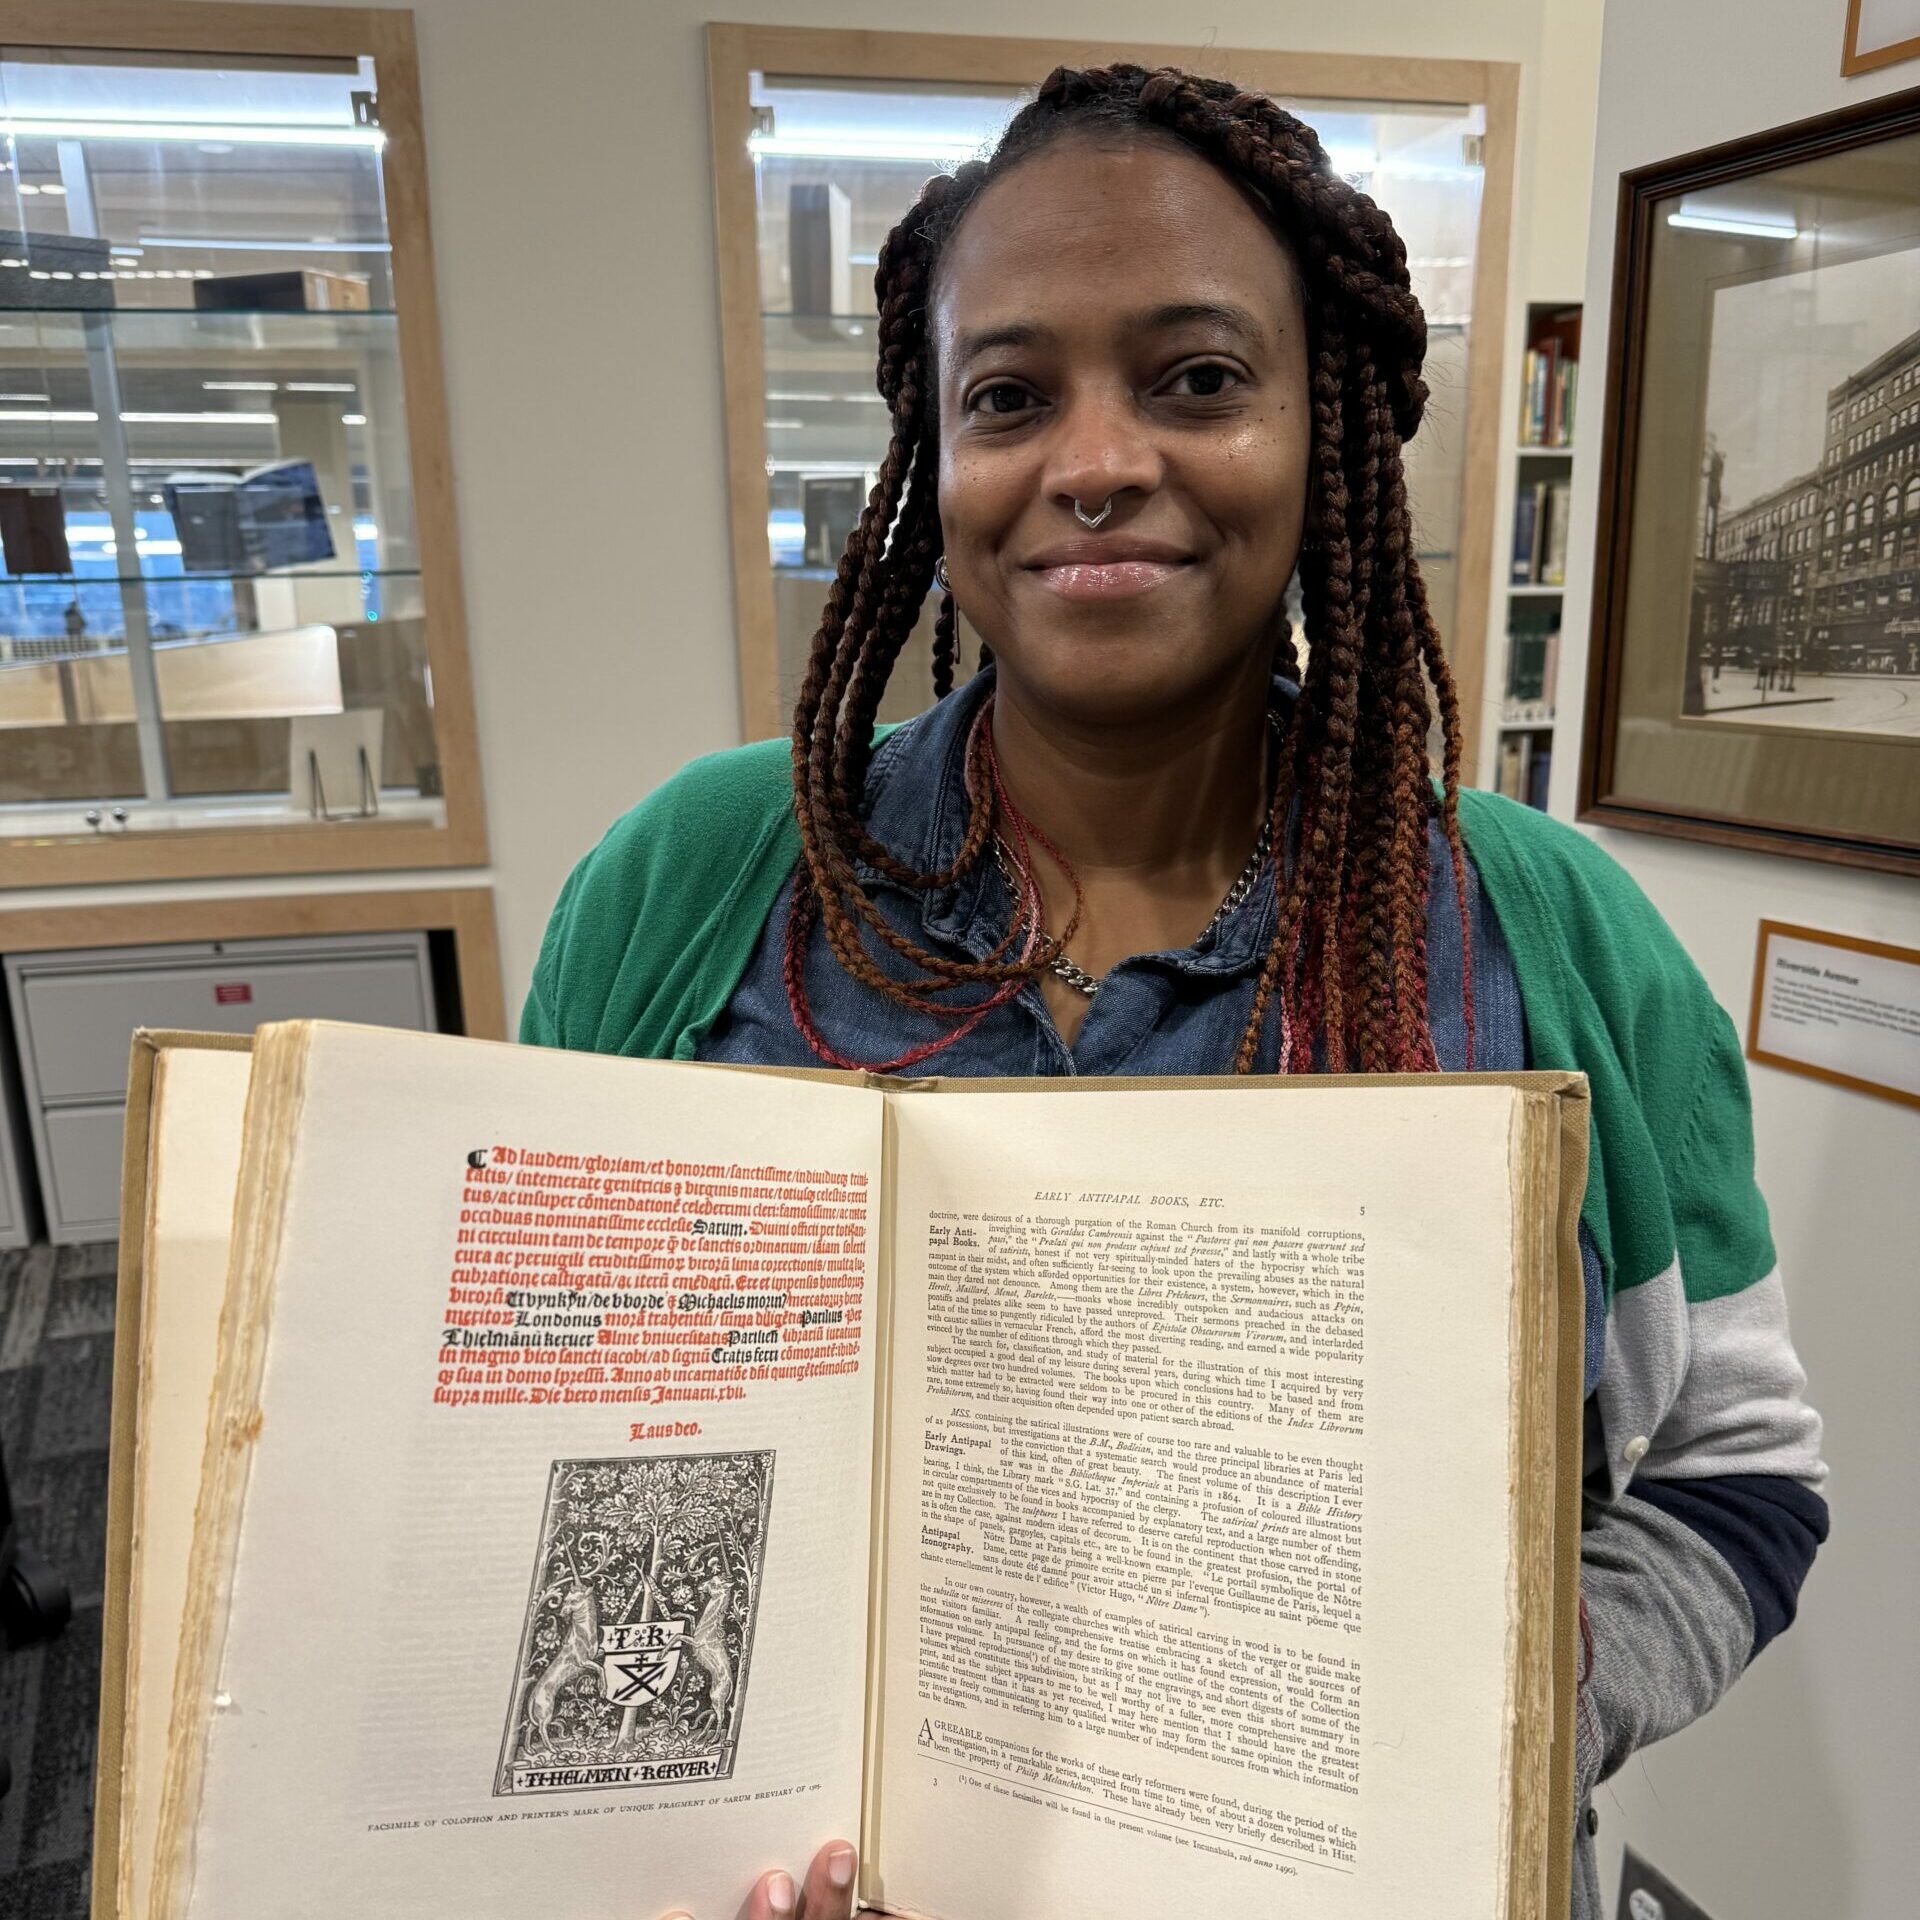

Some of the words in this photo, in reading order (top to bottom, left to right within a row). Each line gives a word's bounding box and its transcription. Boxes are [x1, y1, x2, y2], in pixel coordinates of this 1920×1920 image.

[1823, 969, 1859, 986] Avenue
[1034, 1190, 1072, 1201] EARLY
[1078, 1192, 1140, 1204] ANTIPAPAL
[1149, 1196, 1189, 1207] BOOKS,
[1198, 1197, 1224, 1207] ETC.
[1360, 1206, 1365, 1216] 5
[928, 1210, 959, 1221] doctrine,
[981, 1212, 1012, 1222] desirous
[1014, 1214, 1023, 1222] of
[1035, 1215, 1070, 1227] thorough
[1074, 1218, 1112, 1228] purgation
[1115, 1219, 1124, 1228] of
[1128, 1220, 1142, 1228] the
[1146, 1220, 1176, 1230] Roman
[1180, 1222, 1212, 1232] Church
[1217, 1223, 1238, 1233] from
[1242, 1224, 1254, 1234] its
[1260, 1226, 1300, 1236] manifold
[1307, 1229, 1364, 1241] corruptions,
[929, 1225, 950, 1236] Early
[954, 1226, 976, 1235] Anti-
[928, 1236, 949, 1246] papal
[952, 1236, 979, 1246] Books.
[926, 1323, 952, 1332] evinced
[954, 1325, 963, 1336] by
[965, 1326, 978, 1335] the
[979, 1328, 1007, 1338] number
[1009, 1330, 1018, 1339] of
[1019, 1331, 1049, 1342] editions
[1051, 1334, 1082, 1347] through
[1085, 1338, 1108, 1348] which
[1111, 1340, 1129, 1353] they
[1132, 1344, 1161, 1354] passed.
[926, 1384, 974, 1399] Prohibitorum,
[976, 1391, 990, 1400] and
[992, 1392, 1009, 1402] their
[1011, 1396, 1052, 1408] acquisition
[1054, 1400, 1074, 1410] often
[1076, 1402, 1114, 1416] depended
[1117, 1410, 1137, 1420] upon
[1140, 1412, 1169, 1422] patient
[1171, 1416, 1198, 1426] search
[1201, 1418, 1234, 1431] abroad.
[924, 1431, 947, 1444] Early
[950, 1434, 991, 1448] Antipapal
[924, 1441, 965, 1456] Drawings.
[921, 1525, 960, 1540] Antipapal
[921, 1536, 974, 1554] Iconography.
[933, 1778, 938, 1786] 3
[984, 1736, 1029, 1754] companions
[1031, 1747, 1043, 1758] for
[1045, 1751, 1058, 1762] the
[1060, 1756, 1083, 1768] works
[1086, 1762, 1095, 1771] of
[1098, 1765, 1120, 1778] these
[1122, 1772, 1142, 1786] early
[1145, 1778, 1185, 1795] reformers
[1188, 1790, 1208, 1801] were
[1211, 1793, 1240, 1810] found,
[1242, 1801, 1272, 1820] during
[1276, 1810, 1291, 1822] the
[1294, 1816, 1324, 1830] period
[1327, 1823, 1338, 1834] of
[1341, 1827, 1357, 1838] the
[917, 1736, 930, 1747] had
[933, 1741, 950, 1753] been
[953, 1747, 966, 1758] the
[968, 1753, 1000, 1770] property
[1002, 1762, 1012, 1771] of
[1015, 1764, 1039, 1781] Philip
[1042, 1772, 1094, 1794] Melanchthon.
[1102, 1788, 1128, 1804] These
[1131, 1796, 1151, 1810] have
[1154, 1803, 1185, 1821] already
[1189, 1811, 1210, 1825] been
[1214, 1820, 1234, 1834] very
[1237, 1824, 1265, 1842] briefly
[1270, 1832, 1314, 1852] described
[1318, 1844, 1328, 1856] in
[1332, 1848, 1356, 1862] Hist.
[941, 1732, 989, 1755] investigation,
[990, 1746, 998, 1756] in
[1009, 1753, 1052, 1771] remarkable
[1055, 1766, 1079, 1780] series,
[1081, 1773, 1116, 1789] acquired
[1120, 1782, 1140, 1795] from
[1143, 1789, 1162, 1801] time
[1166, 1795, 1175, 1804] to
[1180, 1798, 1201, 1813] time,
[1206, 1805, 1216, 1815] of
[1220, 1808, 1245, 1822] about
[1257, 1816, 1283, 1832] dozen
[1286, 1826, 1325, 1842] volumes
[1328, 1836, 1356, 1850] which
[367, 1820, 419, 1831] FACSIMILE
[424, 1819, 436, 1827] OF
[441, 1814, 493, 1825] COLOPHON
[496, 1812, 518, 1821] AND
[572, 1806, 599, 1816] MARK
[603, 1805, 616, 1813] OF
[619, 1802, 654, 1812] UNIQUE
[658, 1798, 705, 1809] FRAGMENT
[708, 1796, 720, 1804] OF
[723, 1792, 750, 1803] SARUM
[755, 1786, 793, 1799] BREVIARY
[795, 1784, 805, 1792] OF
[1094, 1812, 1100, 1821] in
